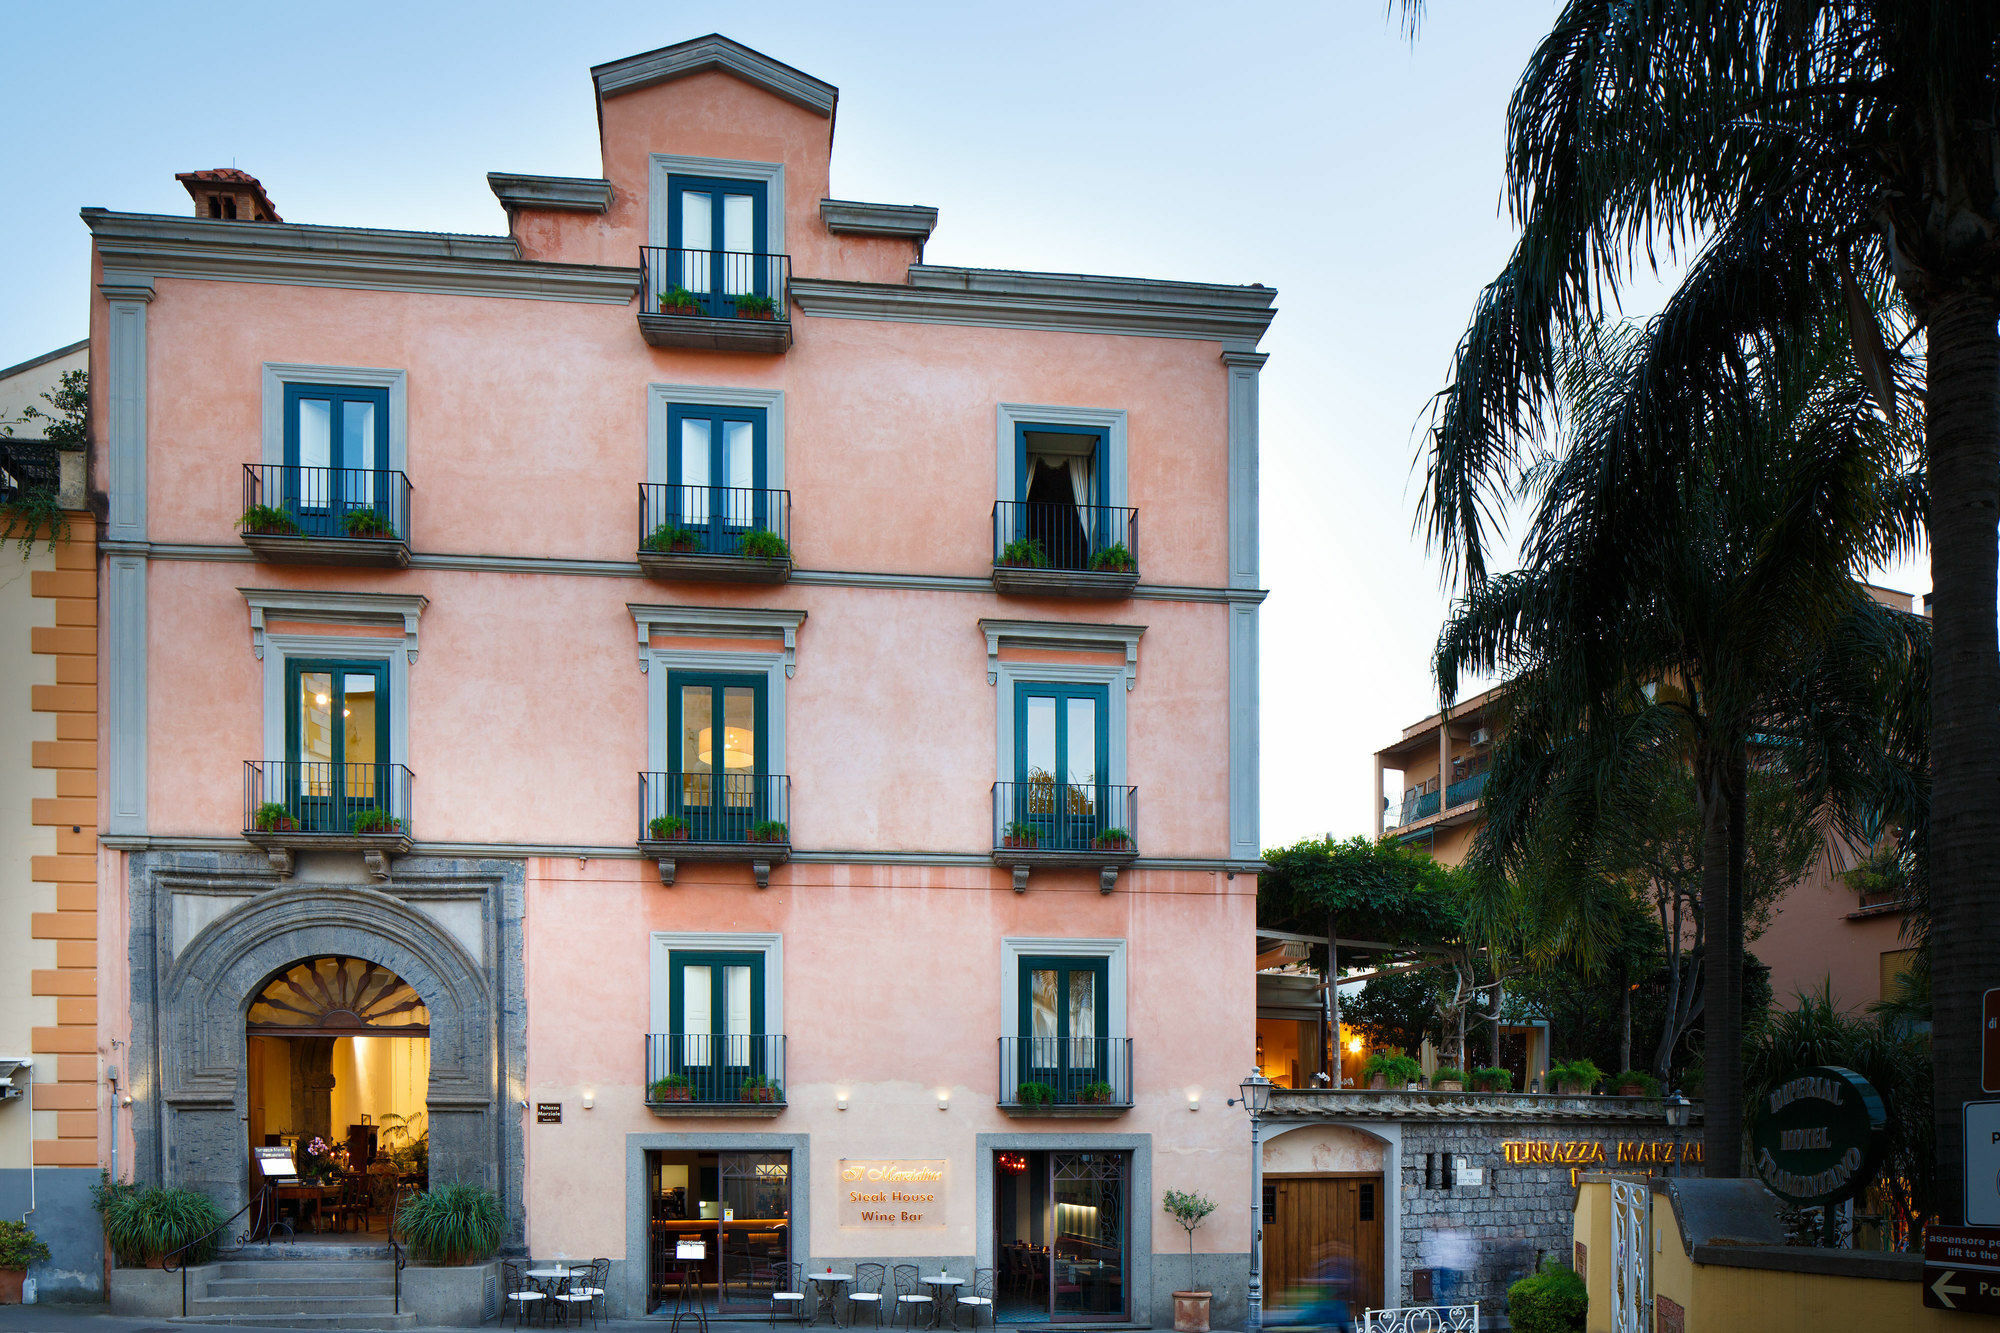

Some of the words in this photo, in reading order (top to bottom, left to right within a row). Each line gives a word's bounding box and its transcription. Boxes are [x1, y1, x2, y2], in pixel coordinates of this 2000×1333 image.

[1988, 1016, 1997, 1029] di
[1768, 1076, 1844, 1115] IMPERIAL
[1780, 1126, 1832, 1150] HOTEL
[1501, 1140, 1607, 1163] TERRAZZA
[850, 1191, 887, 1203] Steak
[892, 1191, 934, 1203] House
[861, 1211, 896, 1222] Wine
[901, 1211, 924, 1222] Bar
[1928, 1235, 1986, 1246] ascensore
[1947, 1246, 1963, 1257] lift
[1966, 1248, 1977, 1258] to
[1980, 1250, 1999, 1261] the
